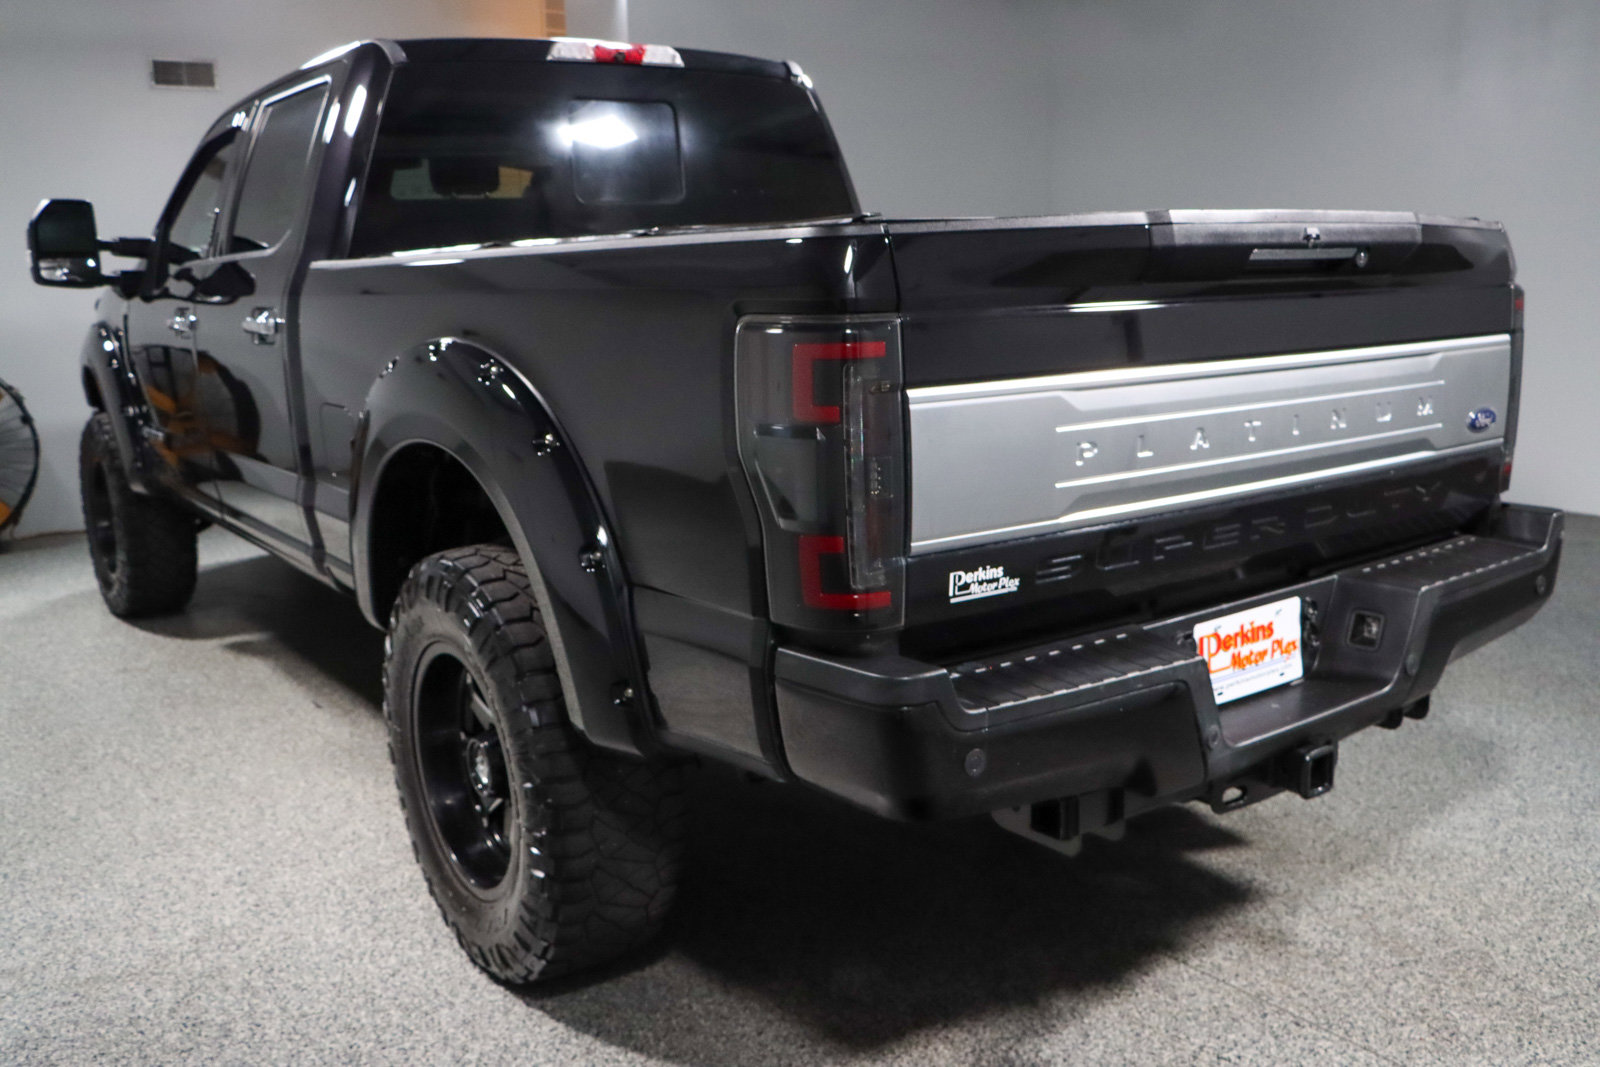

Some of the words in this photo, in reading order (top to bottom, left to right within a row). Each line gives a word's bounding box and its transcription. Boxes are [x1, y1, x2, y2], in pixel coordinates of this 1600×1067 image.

[1075, 396, 1434, 467] PLATINUM
[1034, 515, 1287, 585] SUPER
[1303, 480, 1443, 529] DUTY
[949, 565, 1004, 597] Perkins
[969, 581, 998, 595] Motor
[998, 576, 1020, 589] Plex
[1198, 620, 1274, 674] Perkins
[1230, 648, 1268, 671] Motor
